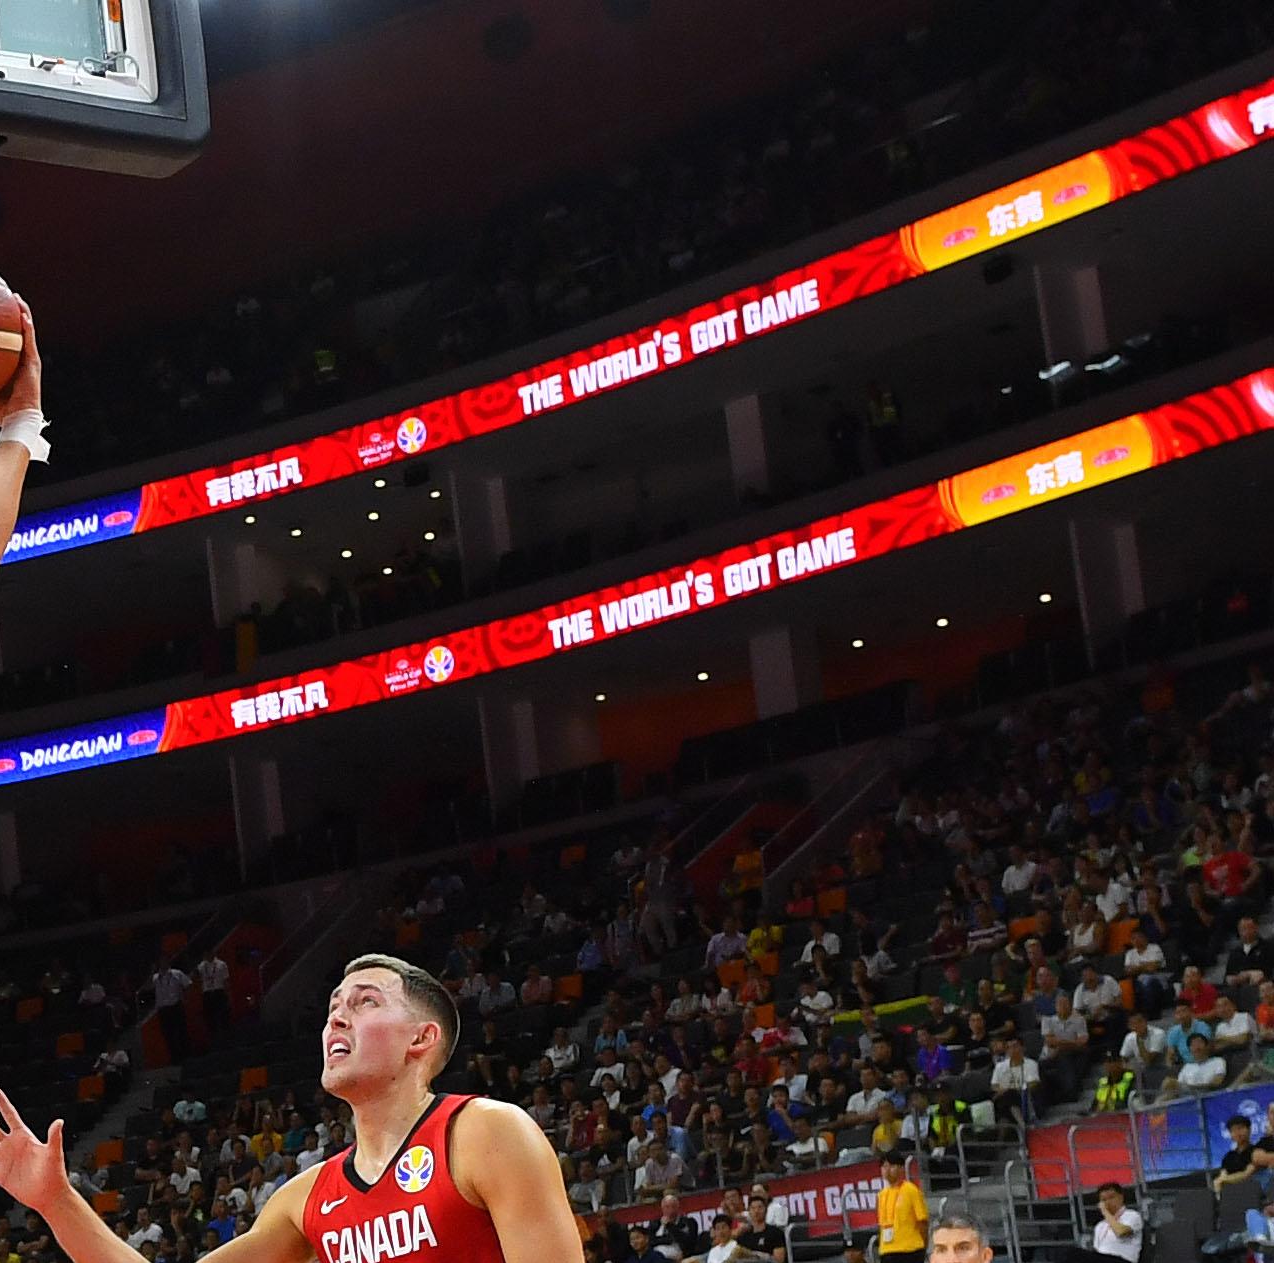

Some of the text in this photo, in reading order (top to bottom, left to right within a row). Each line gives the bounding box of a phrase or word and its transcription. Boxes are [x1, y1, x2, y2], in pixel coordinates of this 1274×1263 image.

[519, 279, 820, 415] THE WORLD'S GOT GAME
[205, 456, 302, 506] 有我不凡
[548, 527, 856, 648] THE WORLD'S GOT GAME
[231, 681, 328, 728] 有我不凡
[20, 733, 122, 771] DONGGUAN
